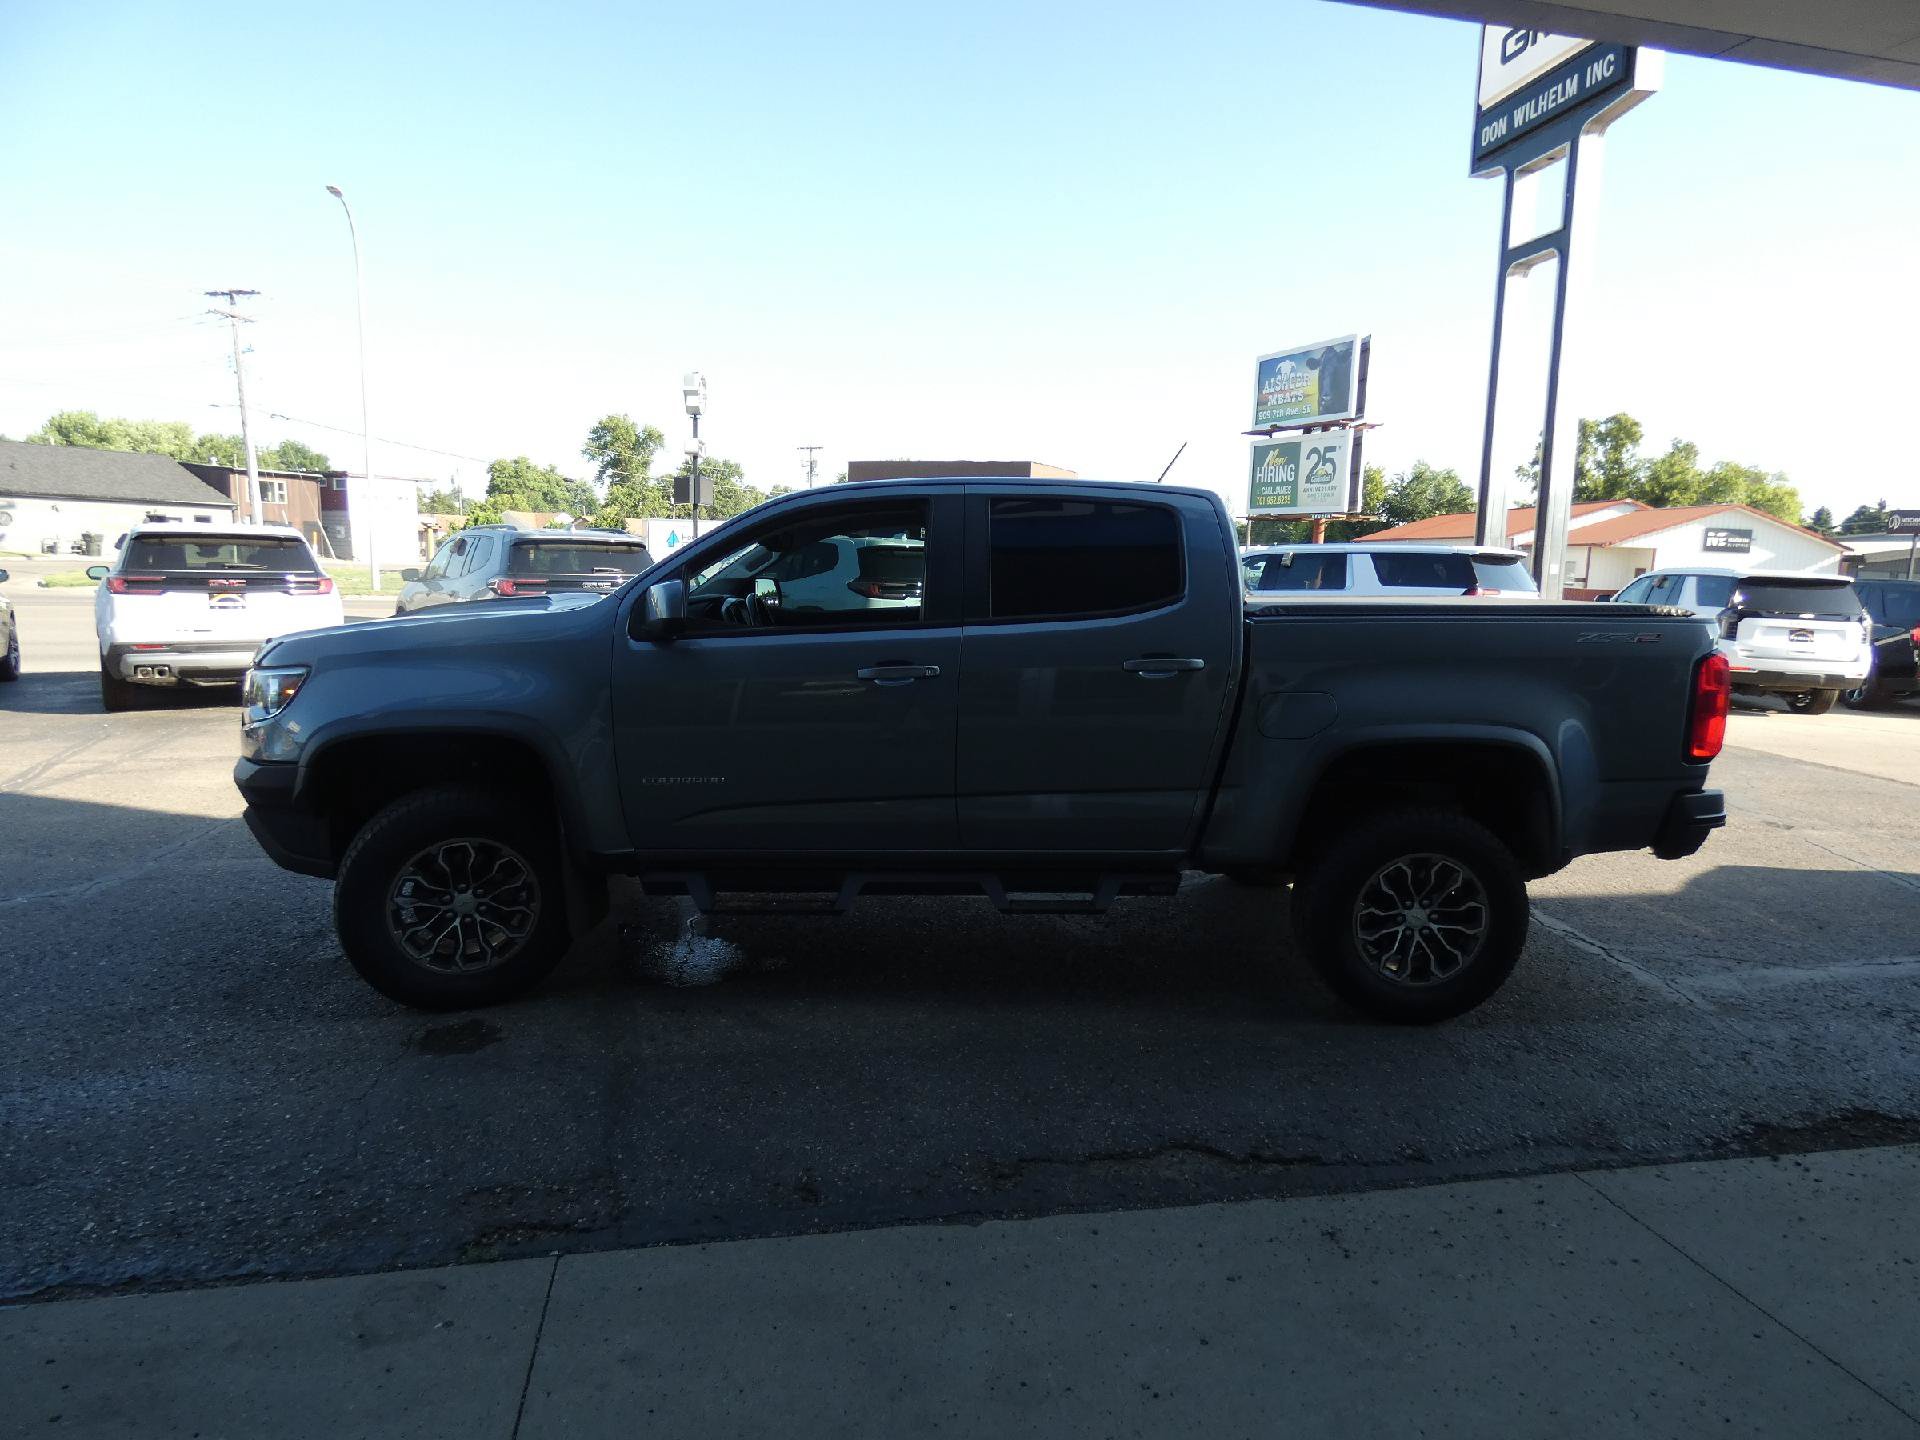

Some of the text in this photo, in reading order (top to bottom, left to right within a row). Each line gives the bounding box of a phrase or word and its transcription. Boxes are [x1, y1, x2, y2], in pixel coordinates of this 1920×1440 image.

[1481, 53, 1615, 146] DON WILHELM INC
[1256, 464, 1295, 482] HIRING
